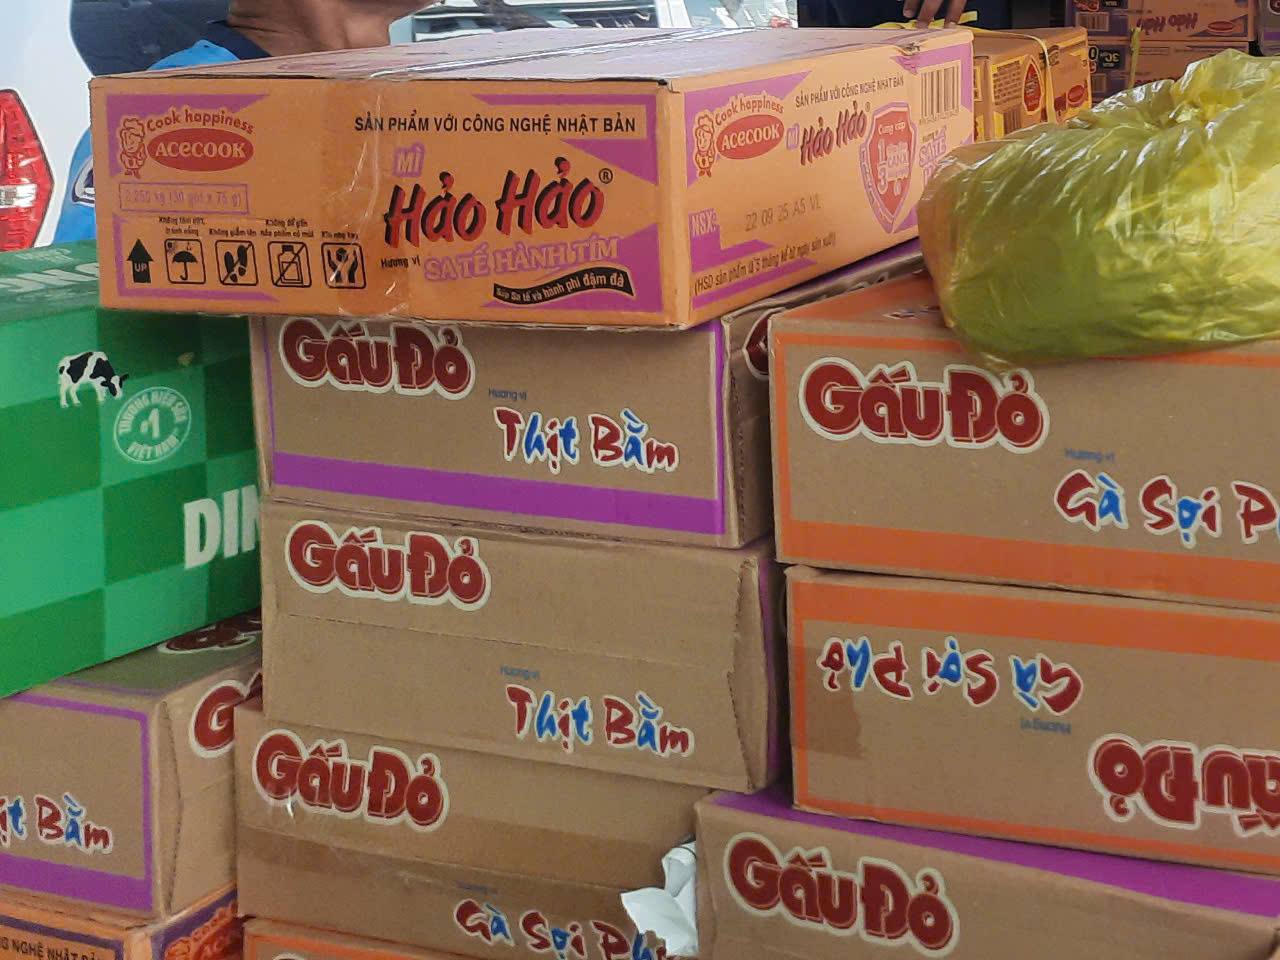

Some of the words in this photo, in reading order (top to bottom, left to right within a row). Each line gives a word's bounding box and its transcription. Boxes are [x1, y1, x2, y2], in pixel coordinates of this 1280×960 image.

[147, 110, 182, 132] Cook
[184, 109, 254, 134] happiness
[354, 111, 384, 132] SẢN
[388, 110, 429, 132] PHẨM
[434, 114, 458, 133] VỚI
[462, 114, 505, 133] CÔNG
[510, 114, 552, 136] NGHỆ
[557, 115, 599, 137] NHẬT
[603, 112, 636, 133] BẢN
[715, 103, 739, 125] Cook
[740, 94, 785, 114] happiness
[795, 93, 810, 108] SẢN
[810, 87, 828, 104] PHẨM
[841, 83, 859, 99] CÔNG
[397, 145, 424, 176] MÌ
[800, 117, 834, 165] Hảo
[836, 101, 867, 148] Hảo
[383, 171, 488, 248] Hảo
[495, 156, 605, 236] Hảo
[135, 262, 147, 272] UP
[381, 257, 409, 269] Hương
[542, 284, 566, 299] hành
[565, 279, 580, 297] phi
[583, 272, 607, 291] đậm
[610, 272, 625, 288] đà
[281, 319, 393, 387] Gấu
[394, 323, 474, 398] Đỏ
[801, 358, 948, 442] Gấu
[948, 365, 1049, 451] Đỏ
[494, 407, 579, 473] Thịt
[589, 409, 679, 473] Bằm
[1054, 469, 1125, 531] Gà
[1140, 474, 1224, 549] Sợi
[287, 523, 405, 598] Gấu
[406, 532, 490, 609] Đỏ
[818, 637, 912, 701] Phở
[922, 637, 1000, 707] Sợi
[1011, 652, 1083, 715] Gà
[506, 685, 594, 753] Thịt
[603, 692, 695, 756] Bằm
[254, 731, 365, 813] Gấu
[367, 748, 447, 829] Đỏ
[1089, 734, 1199, 830] Đỏ
[35, 793, 112, 853] Bằm
[725, 835, 855, 930] Gấu
[855, 857, 960, 954] Đỏ
[454, 899, 515, 947] Gà
[520, 910, 587, 960] Sợi
